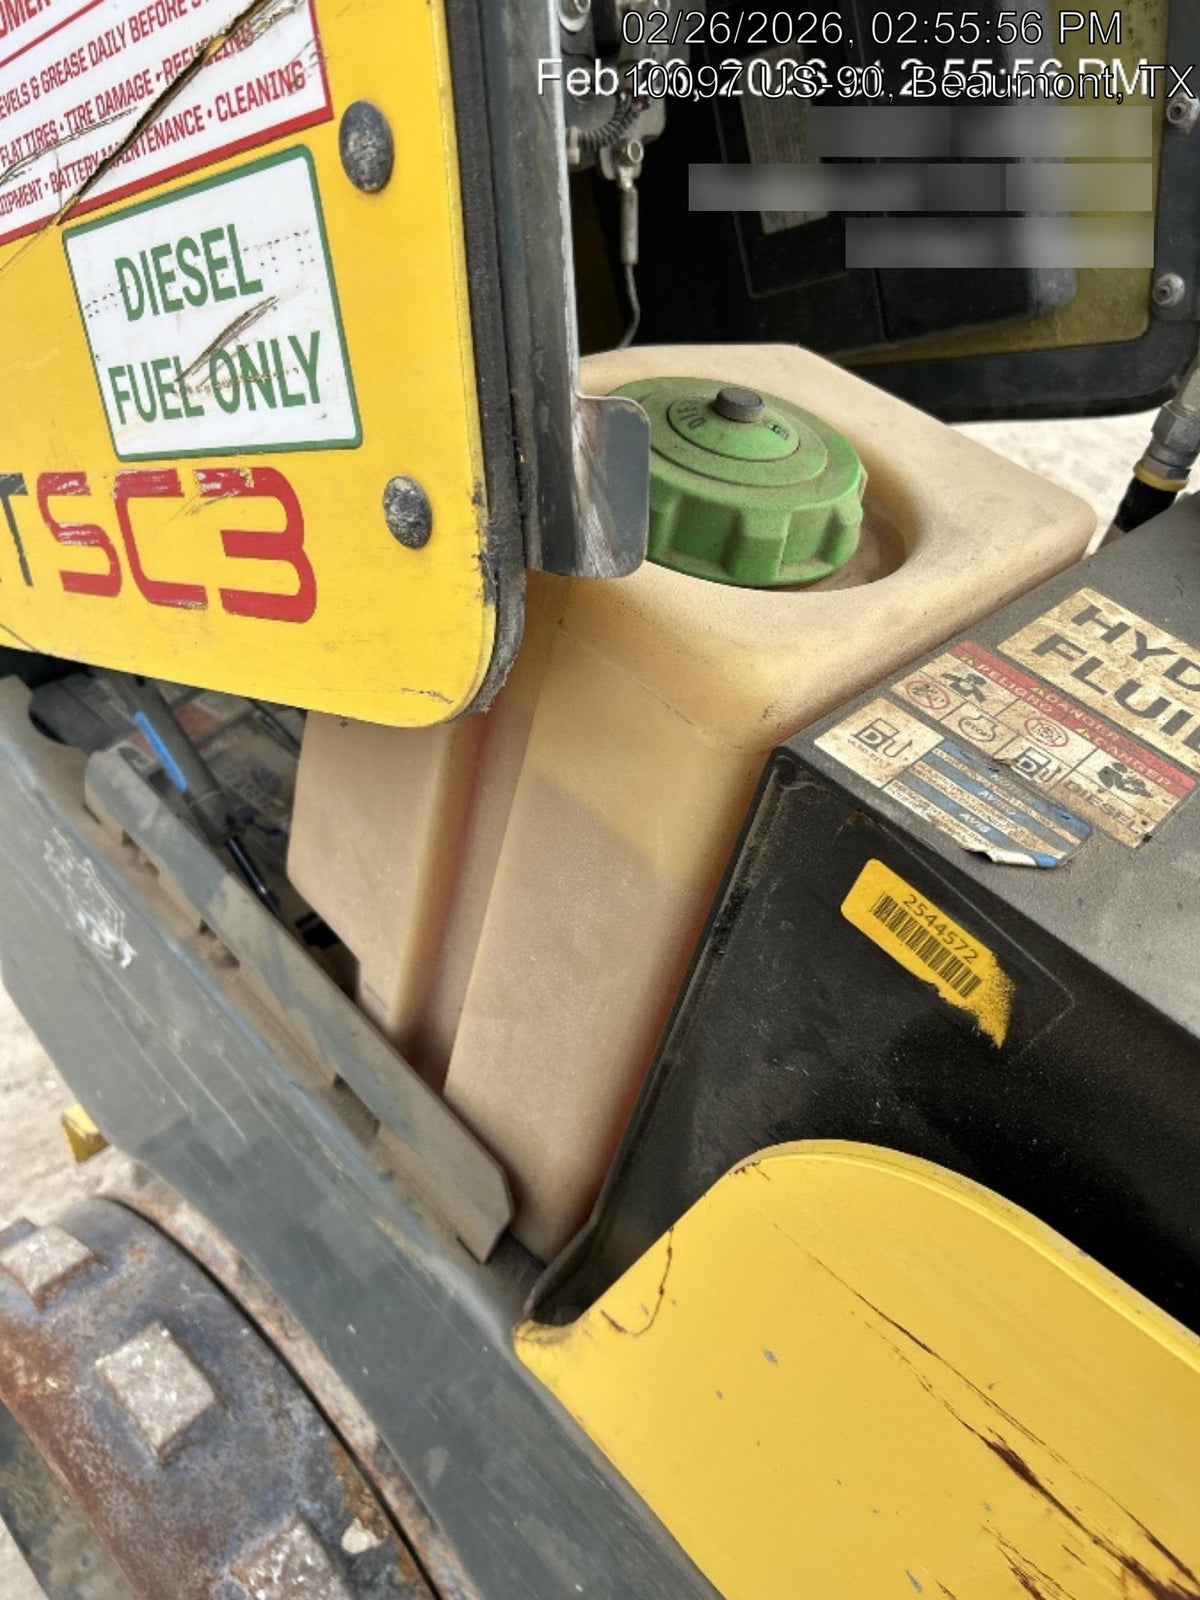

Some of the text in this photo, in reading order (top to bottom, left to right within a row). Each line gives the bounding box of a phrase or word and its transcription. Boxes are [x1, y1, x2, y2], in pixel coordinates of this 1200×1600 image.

[29, 75, 41, 100] &
[40, 46, 88, 94] GREASE
[87, 21, 127, 67] DAILY
[128, 0, 188, 43] BEFORE
[0, 136, 25, 168] FLAT
[23, 119, 60, 155] TIRES
[63, 99, 96, 136] TIRE
[94, 69, 155, 119] DAMAGE
[49, 150, 99, 194] BATTERY
[214, 59, 307, 123] CLEANING
[114, 224, 263, 322] DIESEL
[108, 331, 321, 426] FUEL ONLY
[1070, 604, 1200, 693] HYD
[958, 812, 992, 835] AVIS
[1063, 779, 1140, 834] DIESEL
[902, 893, 979, 965] 2544572
